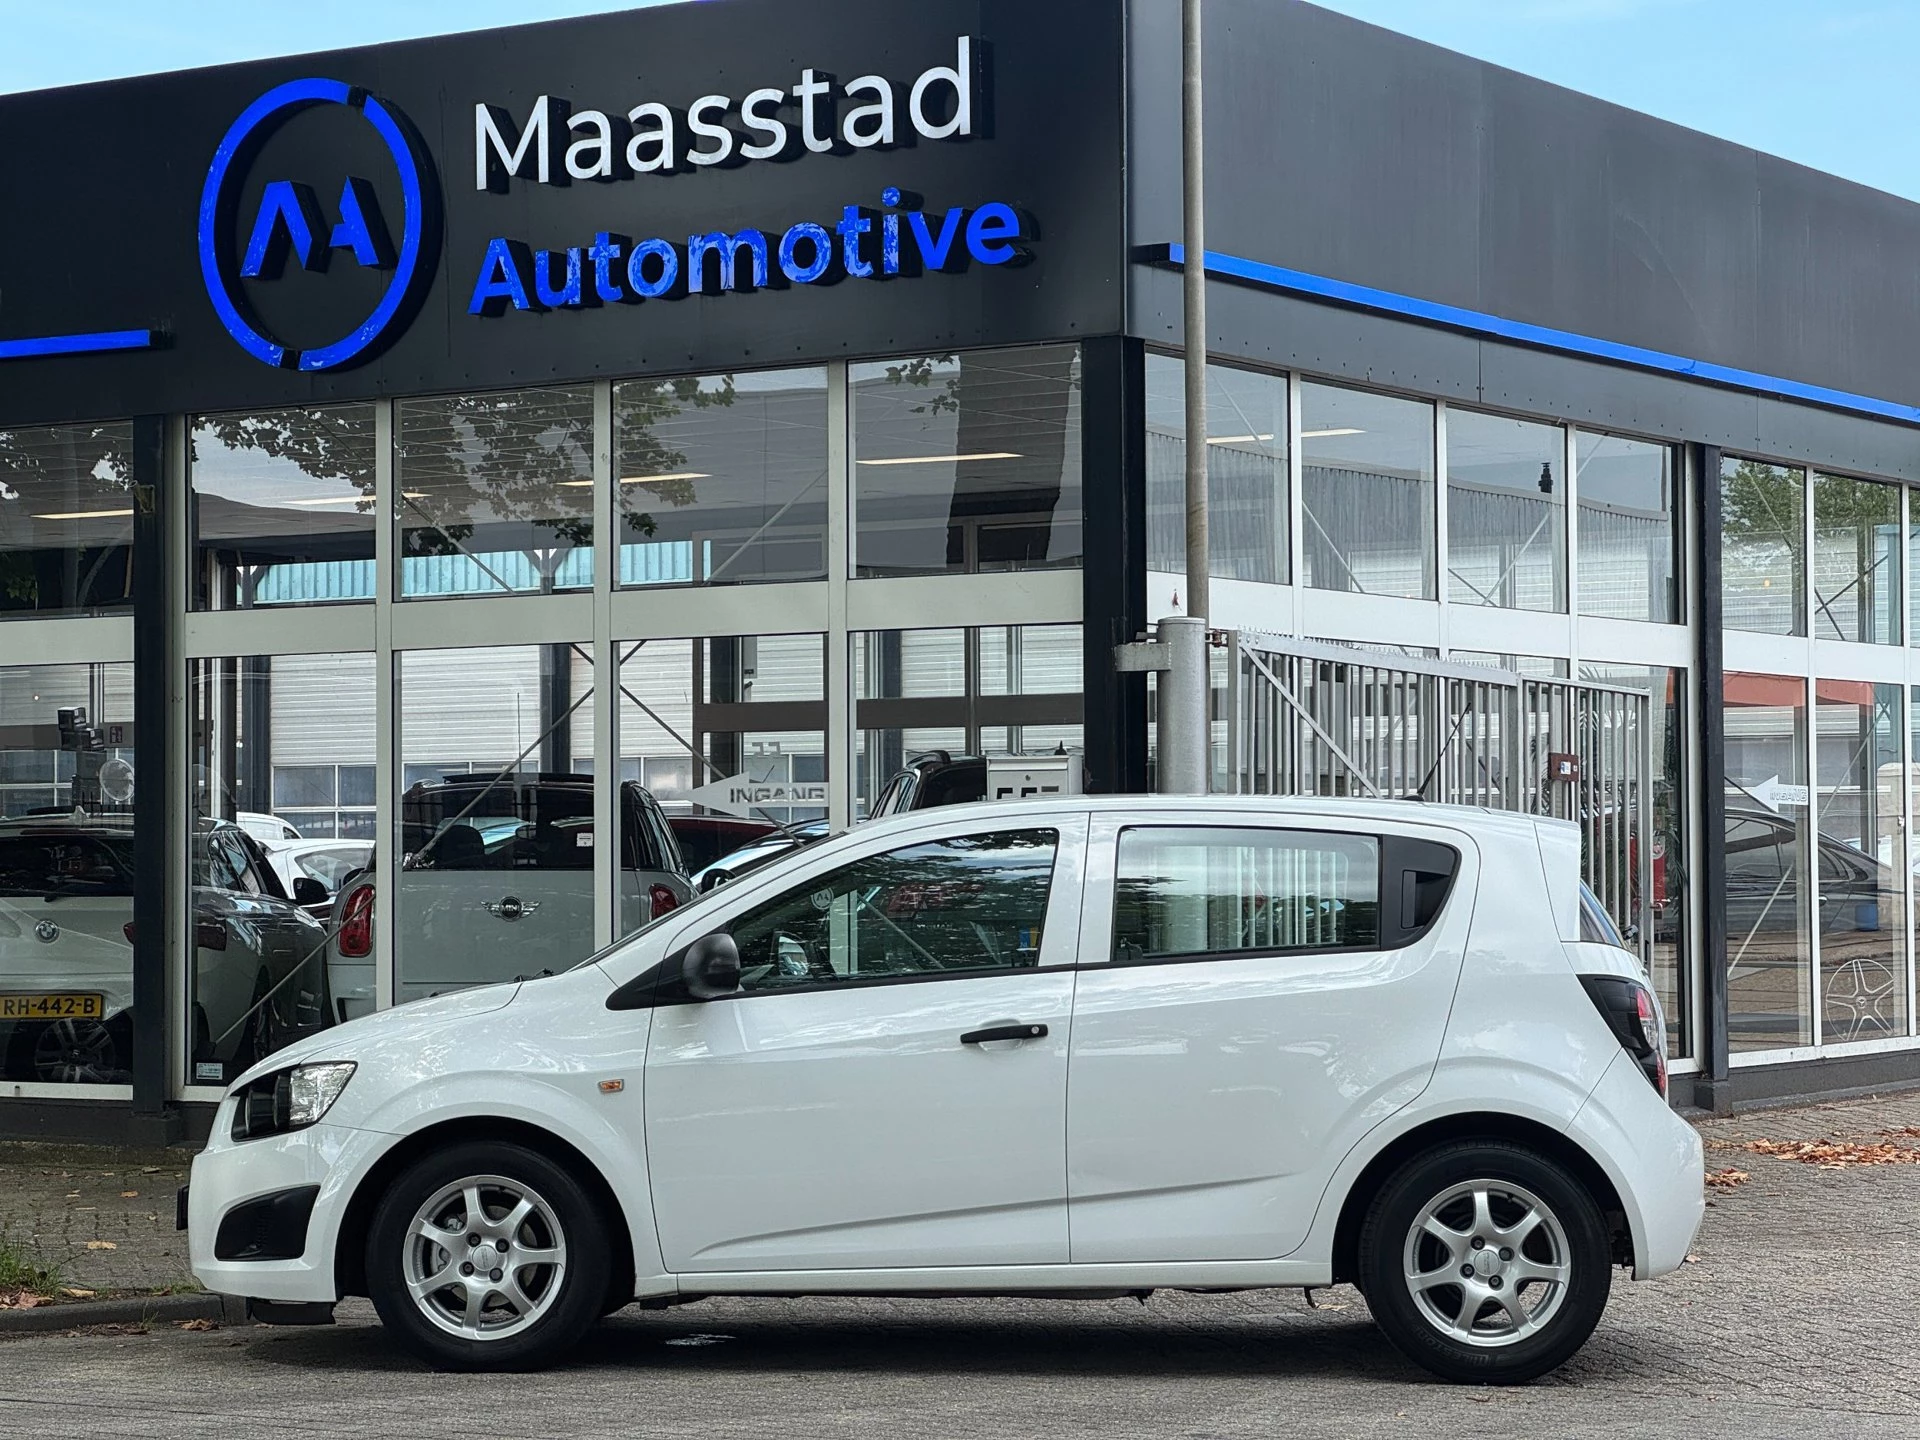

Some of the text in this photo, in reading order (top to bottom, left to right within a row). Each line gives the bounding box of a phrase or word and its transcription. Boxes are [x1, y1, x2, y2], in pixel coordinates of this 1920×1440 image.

[475, 35, 971, 191] Maasstad
[467, 187, 1021, 315] Automotive
[729, 787, 826, 803] INGANG
[3, 997, 96, 1016] RH-442-B
